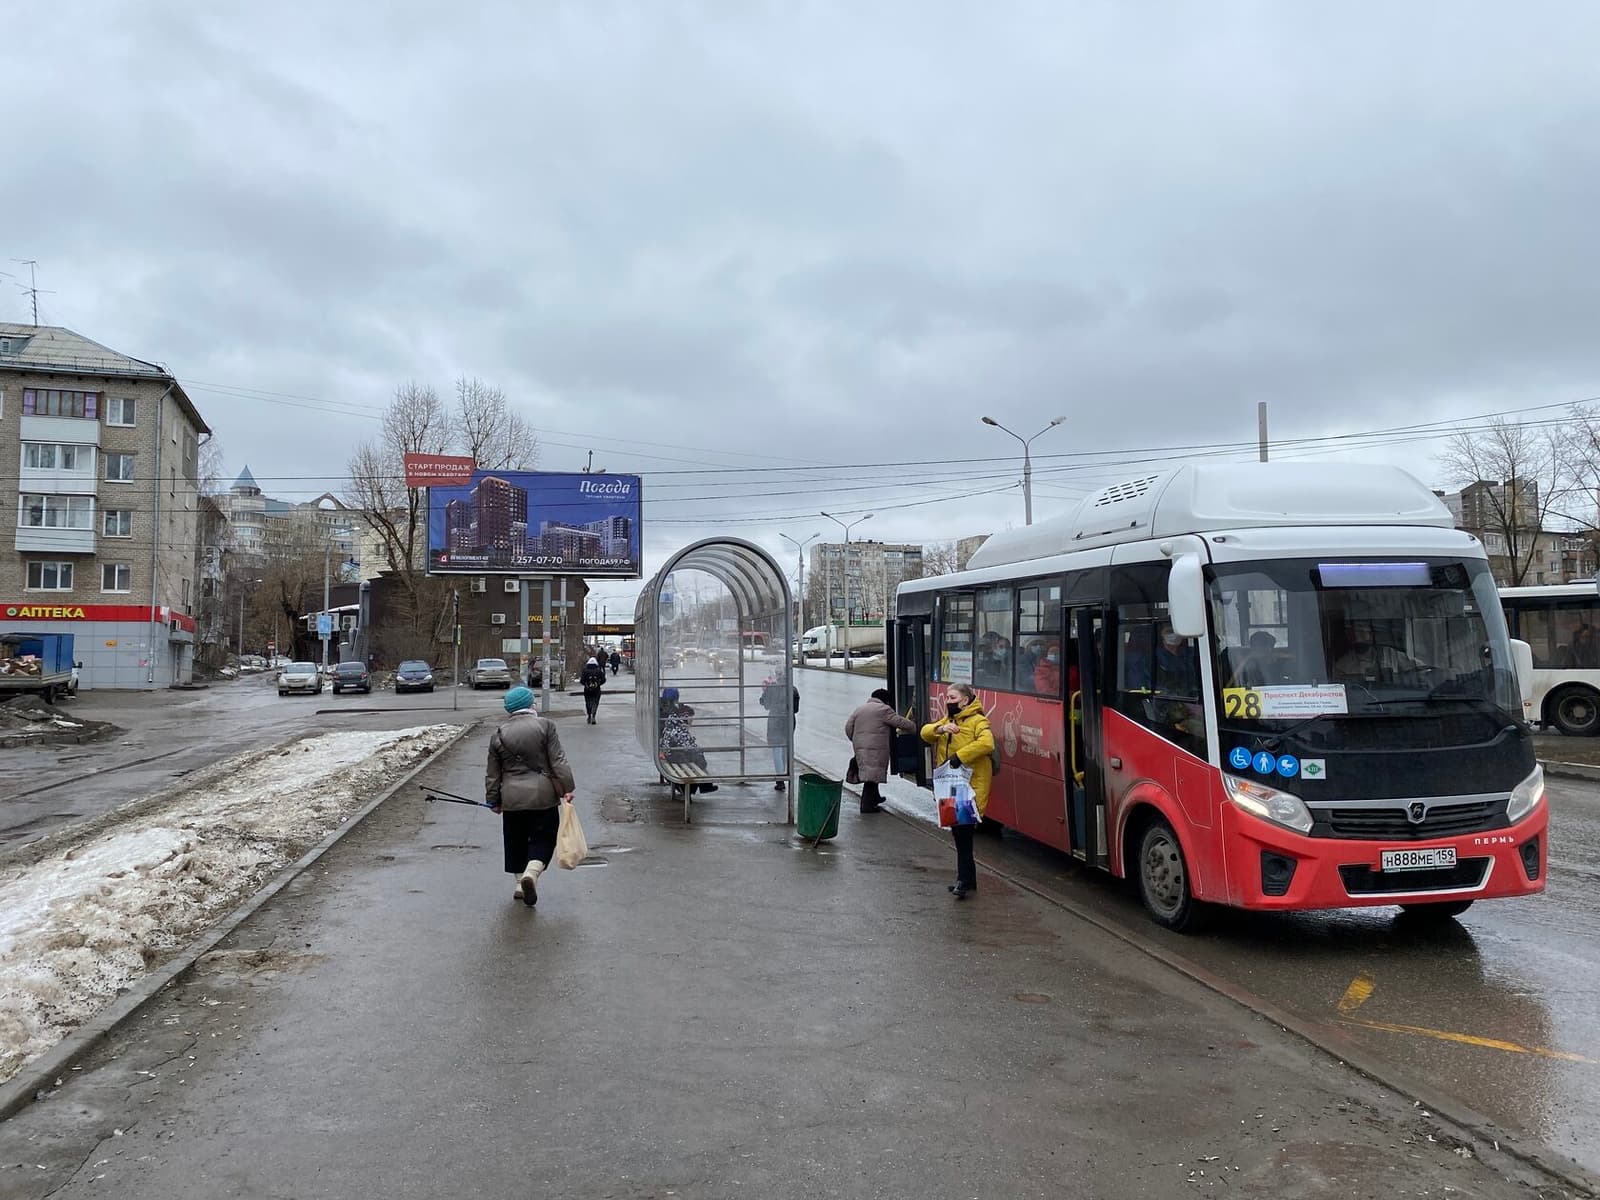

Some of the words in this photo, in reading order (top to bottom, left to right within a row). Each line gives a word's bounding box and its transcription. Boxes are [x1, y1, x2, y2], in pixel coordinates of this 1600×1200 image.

[580, 480, 631, 493] Погода
[517, 556, 563, 564] 257-07-70
[19, 606, 85, 618] АПТЕКА
[1226, 693, 1261, 719] 28
[1474, 837, 1514, 845] ПЕРМЬ
[1385, 852, 1434, 867] Н888МЕ
[1435, 849, 1455, 860] 159
